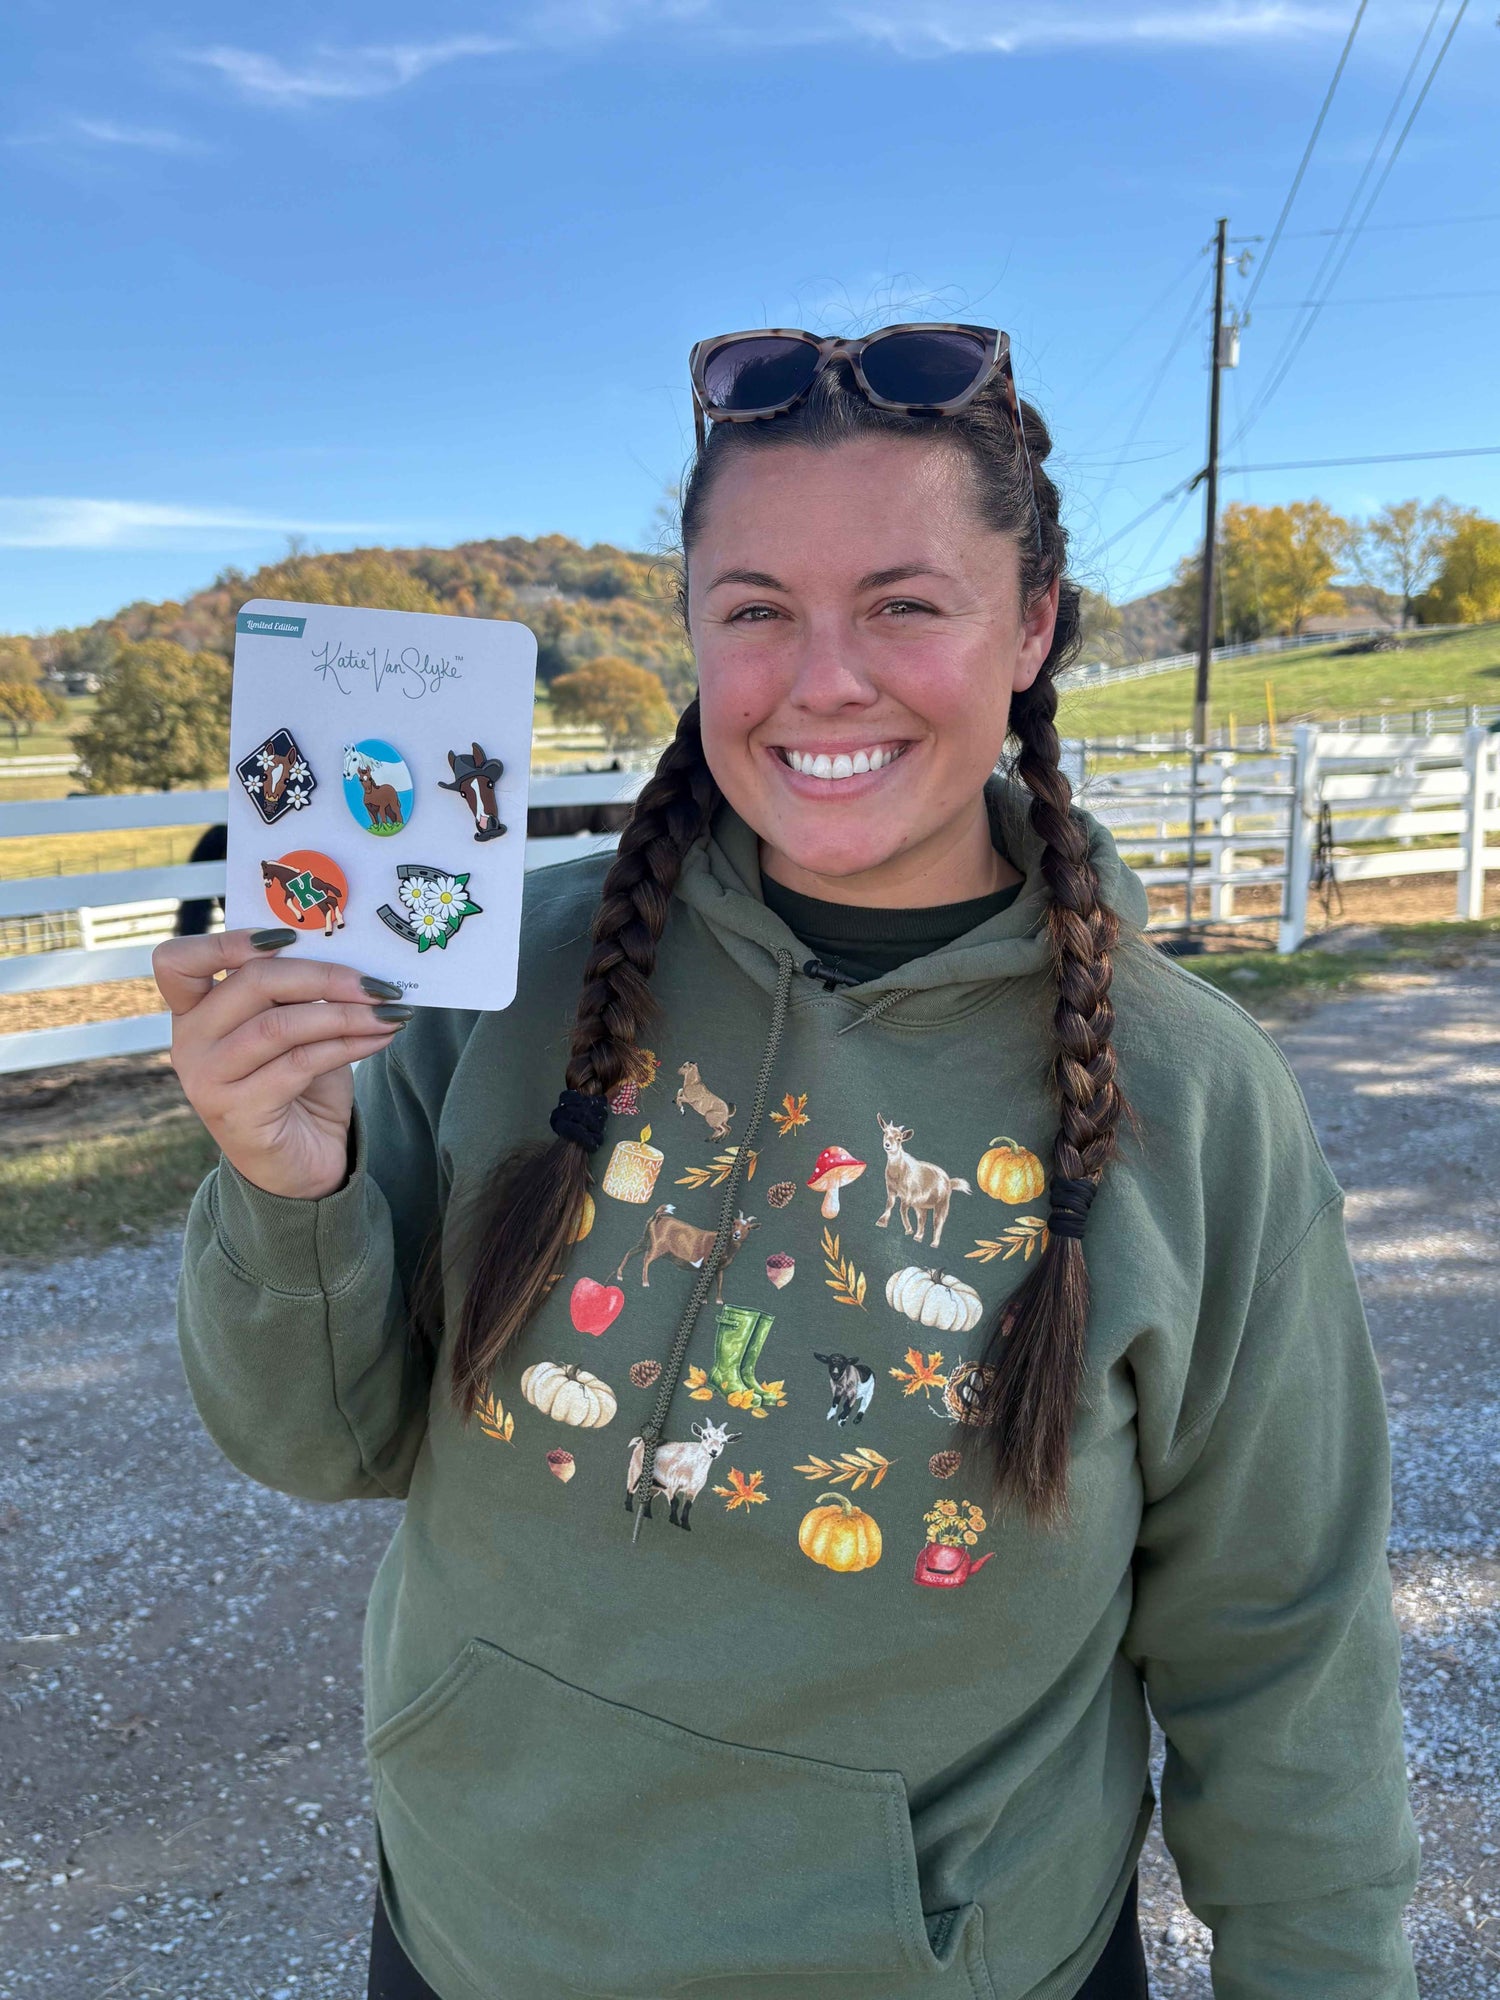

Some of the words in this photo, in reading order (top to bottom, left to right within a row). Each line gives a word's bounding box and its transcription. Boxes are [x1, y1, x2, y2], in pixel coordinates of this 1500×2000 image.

[246, 619, 274, 631] Limited
[274, 622, 299, 632] Edition
[312, 641, 370, 695] Katie
[366, 648, 405, 692] Van
[400, 647, 462, 699] Slyke
[286, 870, 328, 911] K
[396, 980, 419, 991] Slyke
